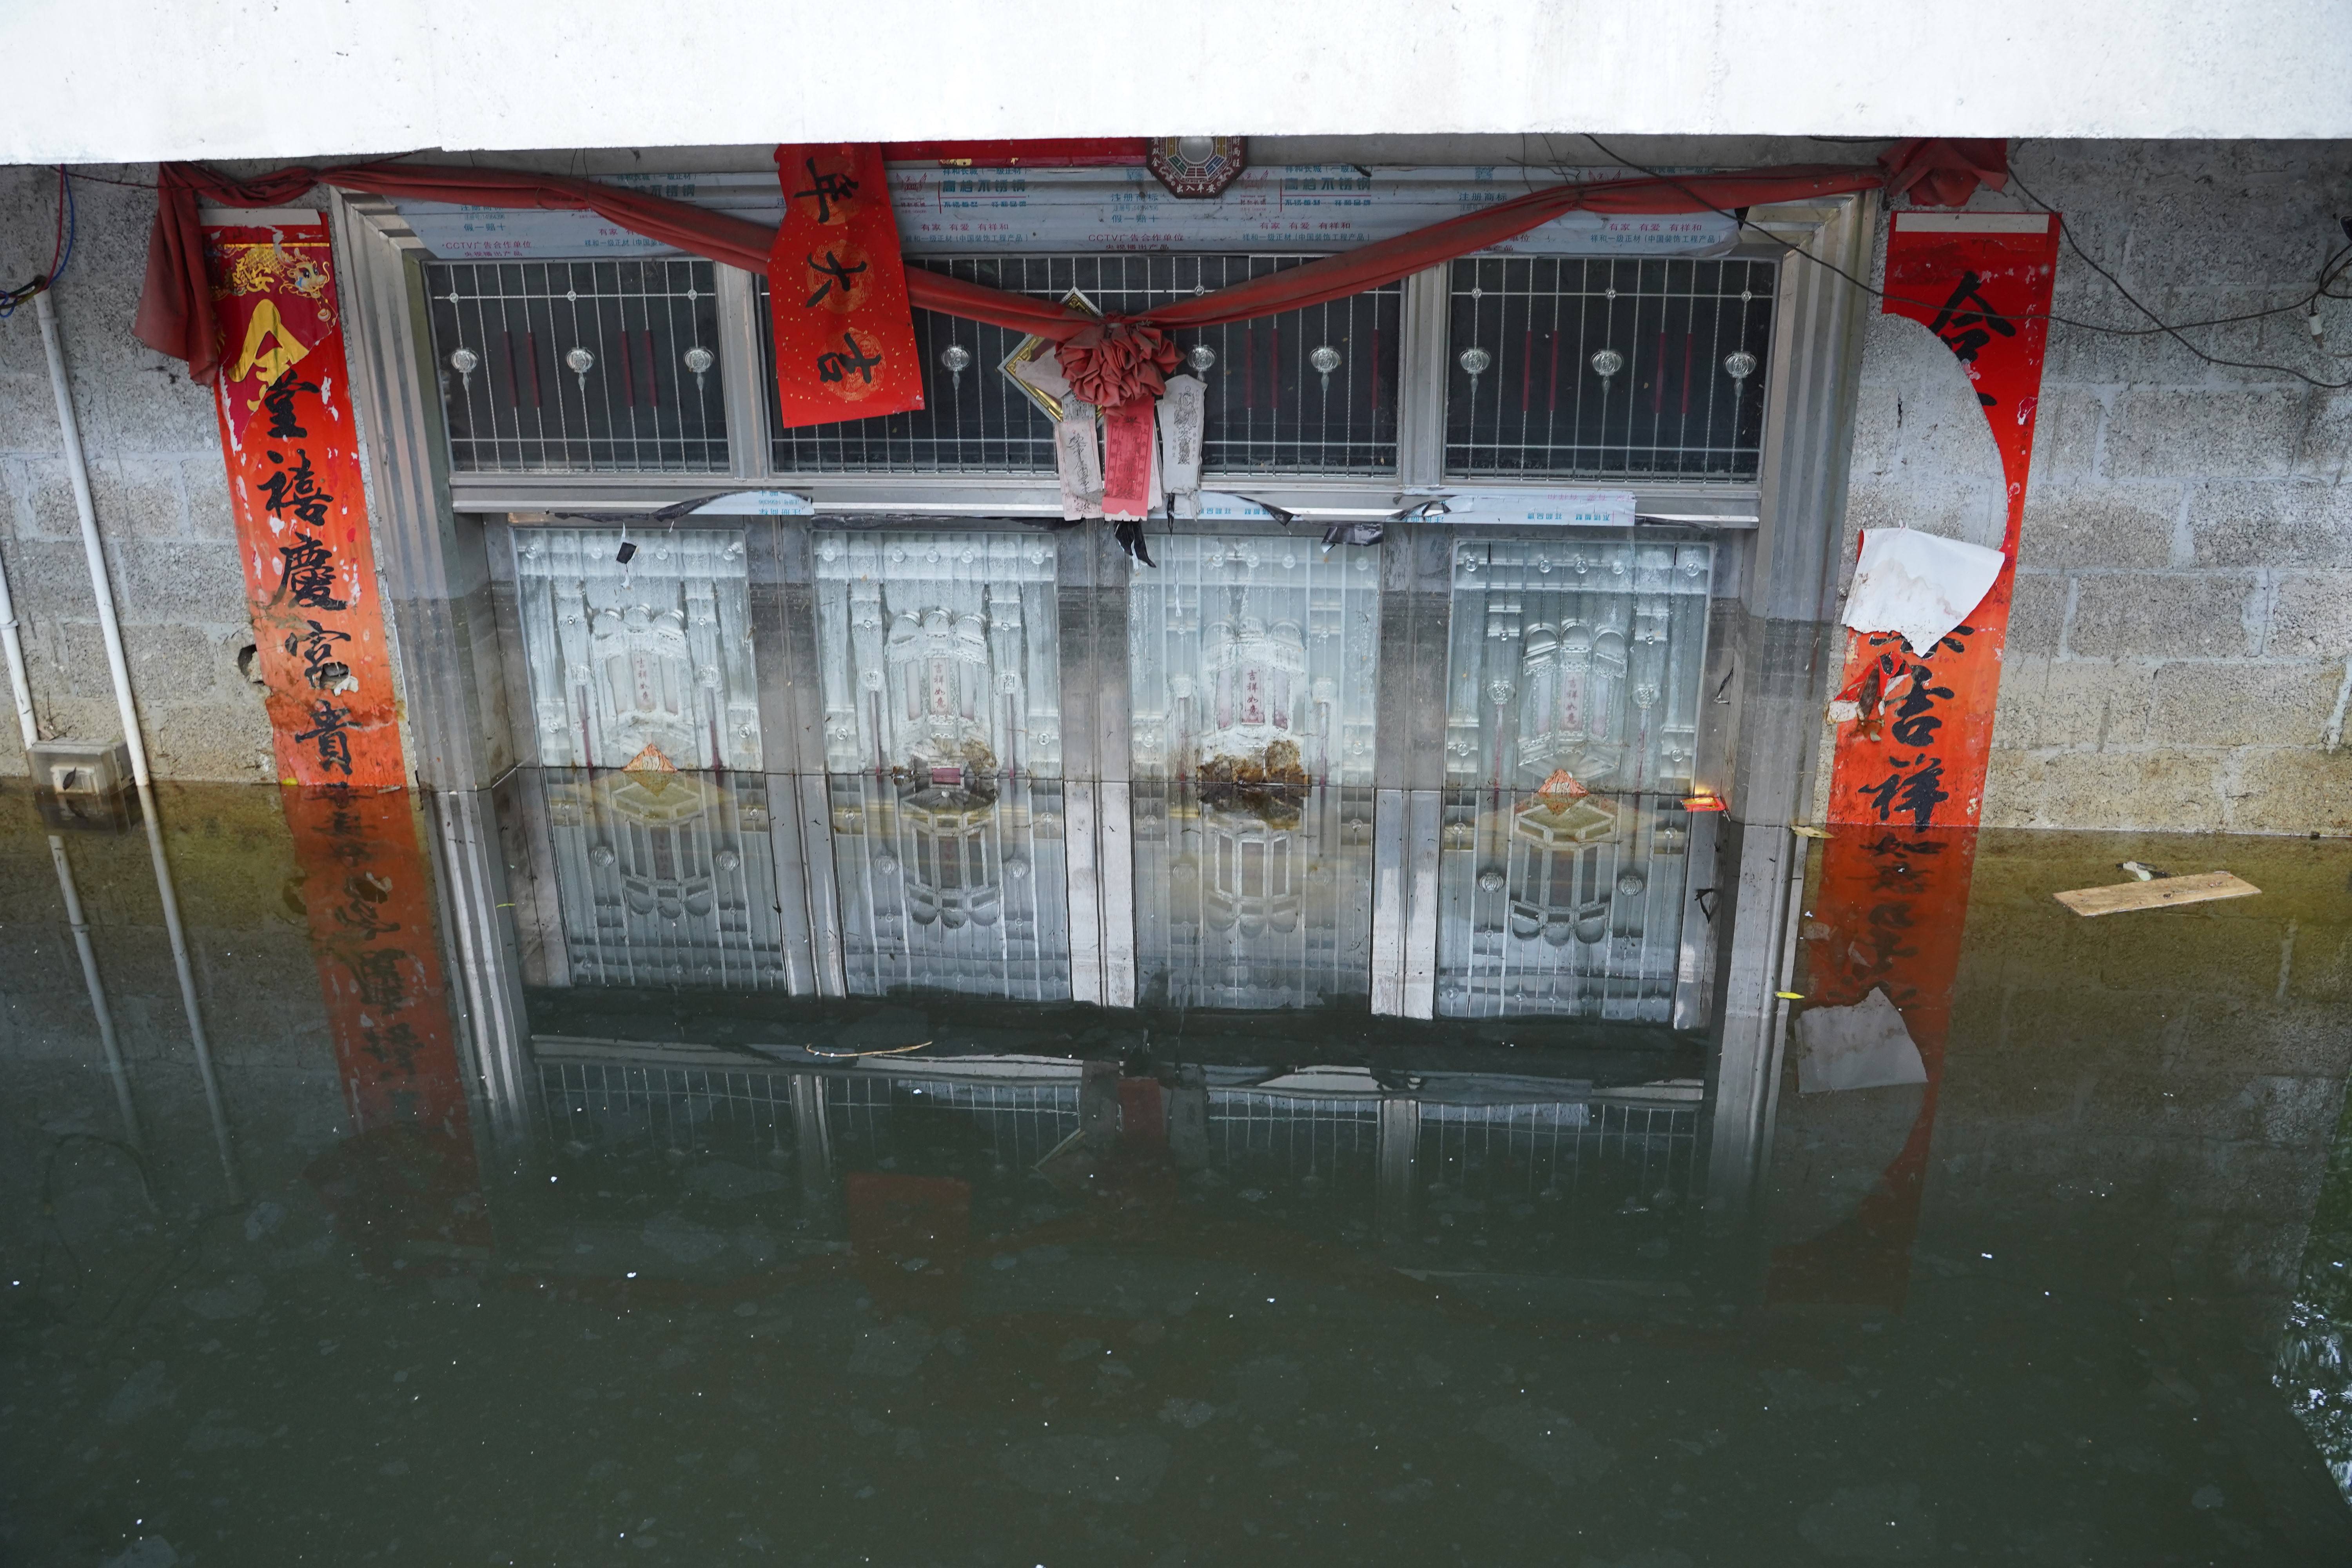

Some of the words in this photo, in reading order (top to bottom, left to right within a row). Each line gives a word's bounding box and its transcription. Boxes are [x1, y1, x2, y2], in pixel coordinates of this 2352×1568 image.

[943, 179, 1025, 192] 高档不锈钢
[1177, 184, 1216, 194] 出入平安
[1285, 178, 1371, 191] 高档不锈钢
[1111, 193, 1159, 202] 注册商标
[1459, 192, 1508, 201] 注册商标
[1111, 214, 1160, 223] 假一赔十
[464, 223, 506, 232] 假一赔十
[1609, 223, 1630, 231] 有家
[1639, 223, 1661, 231] 有爱
[1669, 223, 1702, 231] 有祥和
[446, 241, 531, 249] CCTV广告合作单位
